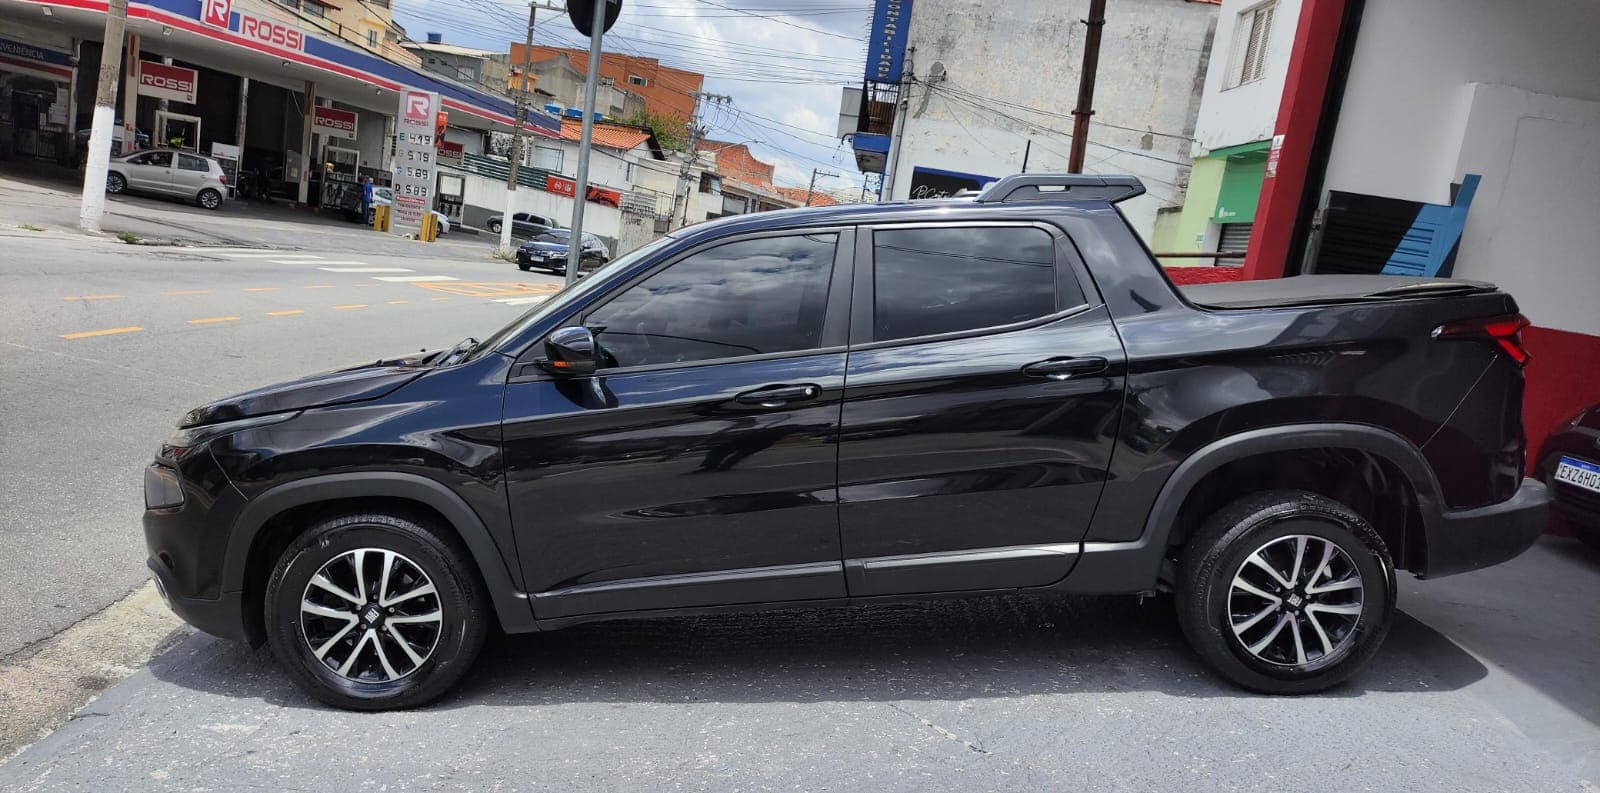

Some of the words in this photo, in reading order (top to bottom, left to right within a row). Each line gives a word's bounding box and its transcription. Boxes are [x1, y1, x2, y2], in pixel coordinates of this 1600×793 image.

[242, 15, 302, 51] ROSSI
[141, 73, 193, 92] ROSSI
[407, 95, 429, 116] R
[315, 116, 354, 130] ROSSI
[403, 118, 429, 128] ROSSI
[399, 132, 405, 141] E
[438, 148, 462, 159] OSSI
